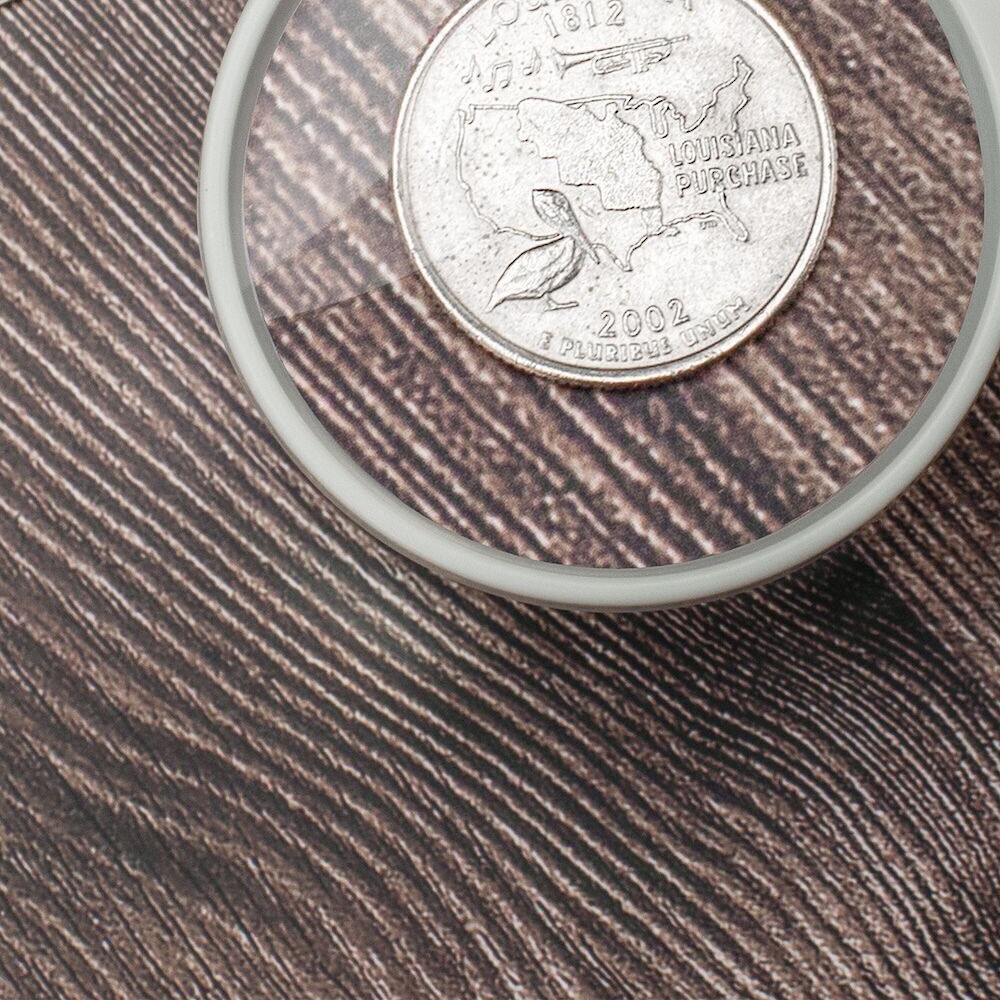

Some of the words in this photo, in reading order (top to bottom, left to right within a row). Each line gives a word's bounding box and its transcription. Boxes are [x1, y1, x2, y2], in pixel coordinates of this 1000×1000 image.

[543, 0, 624, 38] 1812
[668, 122, 801, 167] LOUISIANA
[675, 152, 808, 198] PURCHASE
[598, 297, 690, 338] 2002
